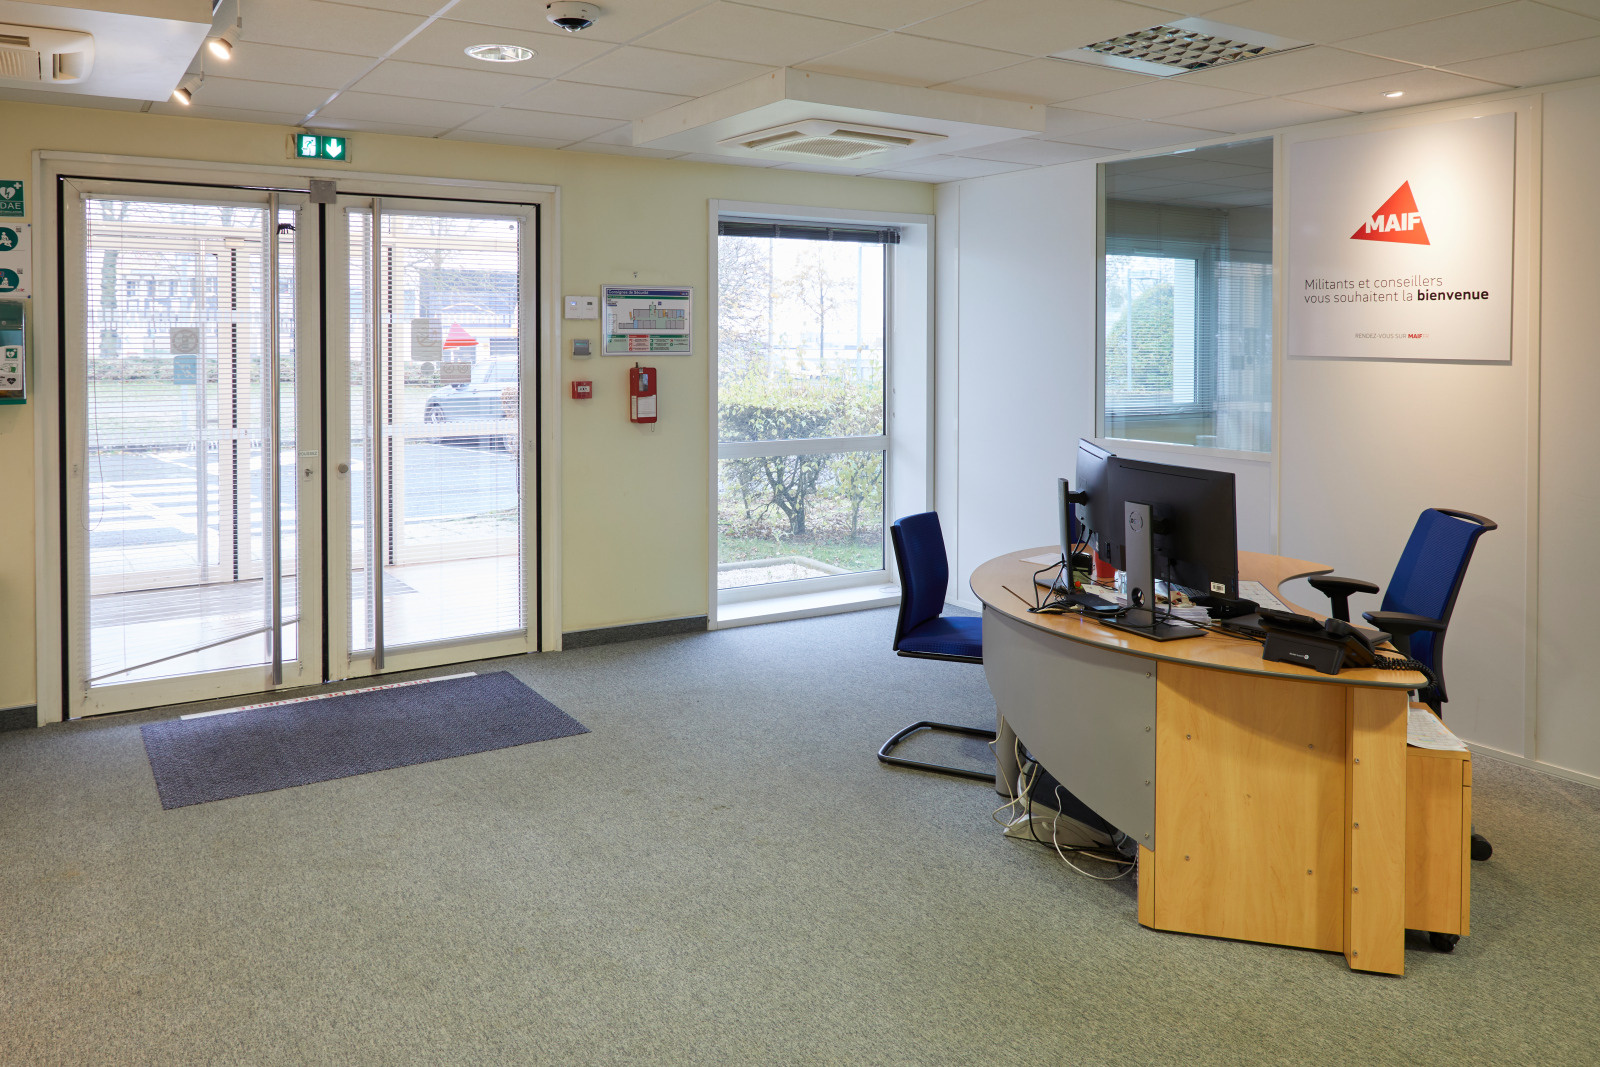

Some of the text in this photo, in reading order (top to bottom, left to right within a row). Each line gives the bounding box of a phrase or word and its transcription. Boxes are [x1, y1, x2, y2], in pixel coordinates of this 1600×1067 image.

[0, 202, 22, 210] DAE
[1365, 212, 1421, 234] MAIF
[1304, 274, 1443, 290] Militants et conseillers
[1303, 288, 1489, 304] vous souhaitent la bienvenue
